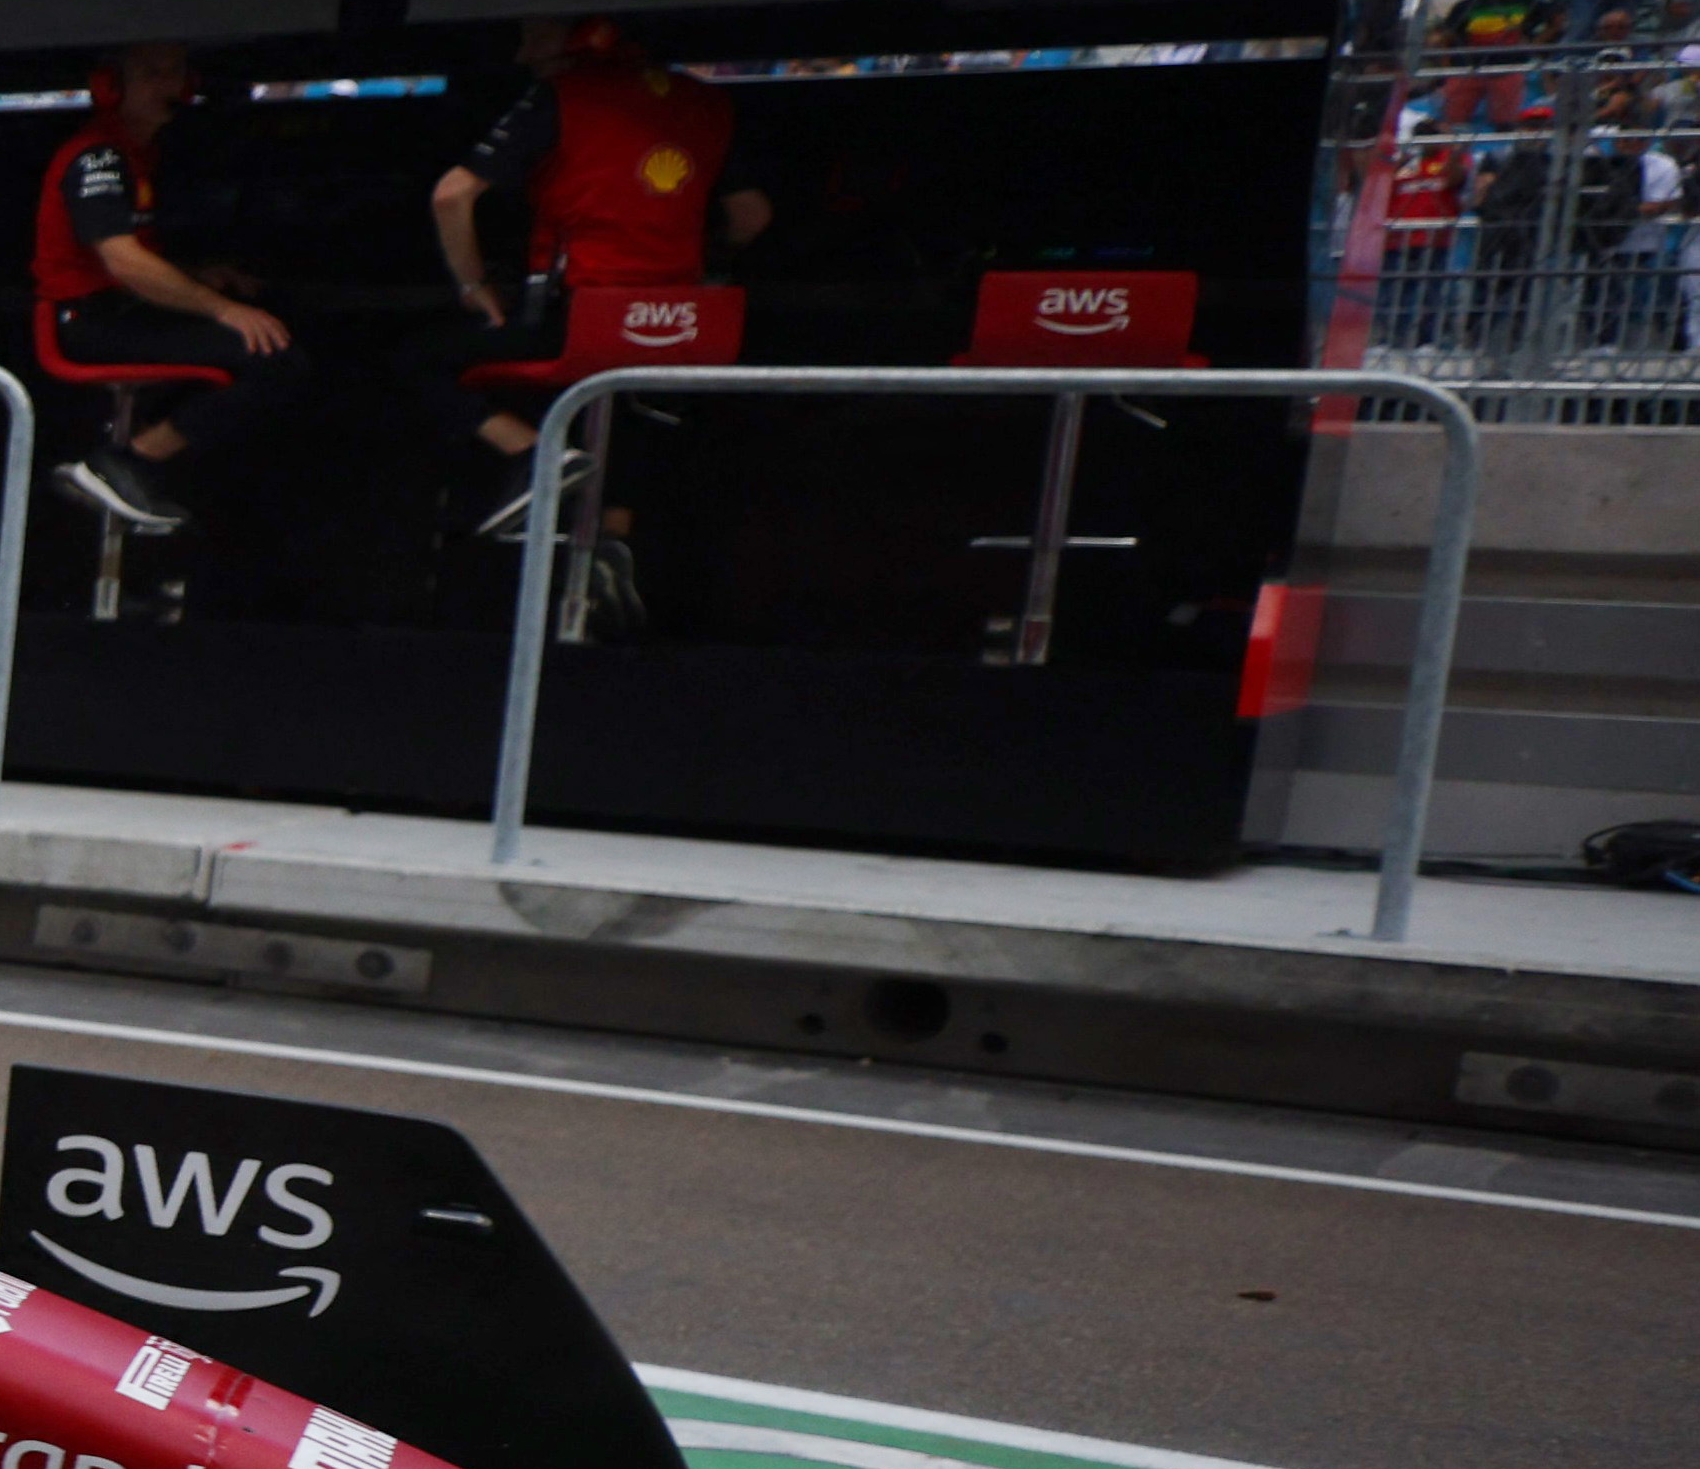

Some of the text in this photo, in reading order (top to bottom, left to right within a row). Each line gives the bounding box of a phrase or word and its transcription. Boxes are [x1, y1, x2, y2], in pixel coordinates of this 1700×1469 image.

[623, 299, 698, 328] aws
[1039, 287, 1129, 317] aws
[44, 1133, 336, 1251] aws
[115, 1344, 192, 1411] PIRELLI
